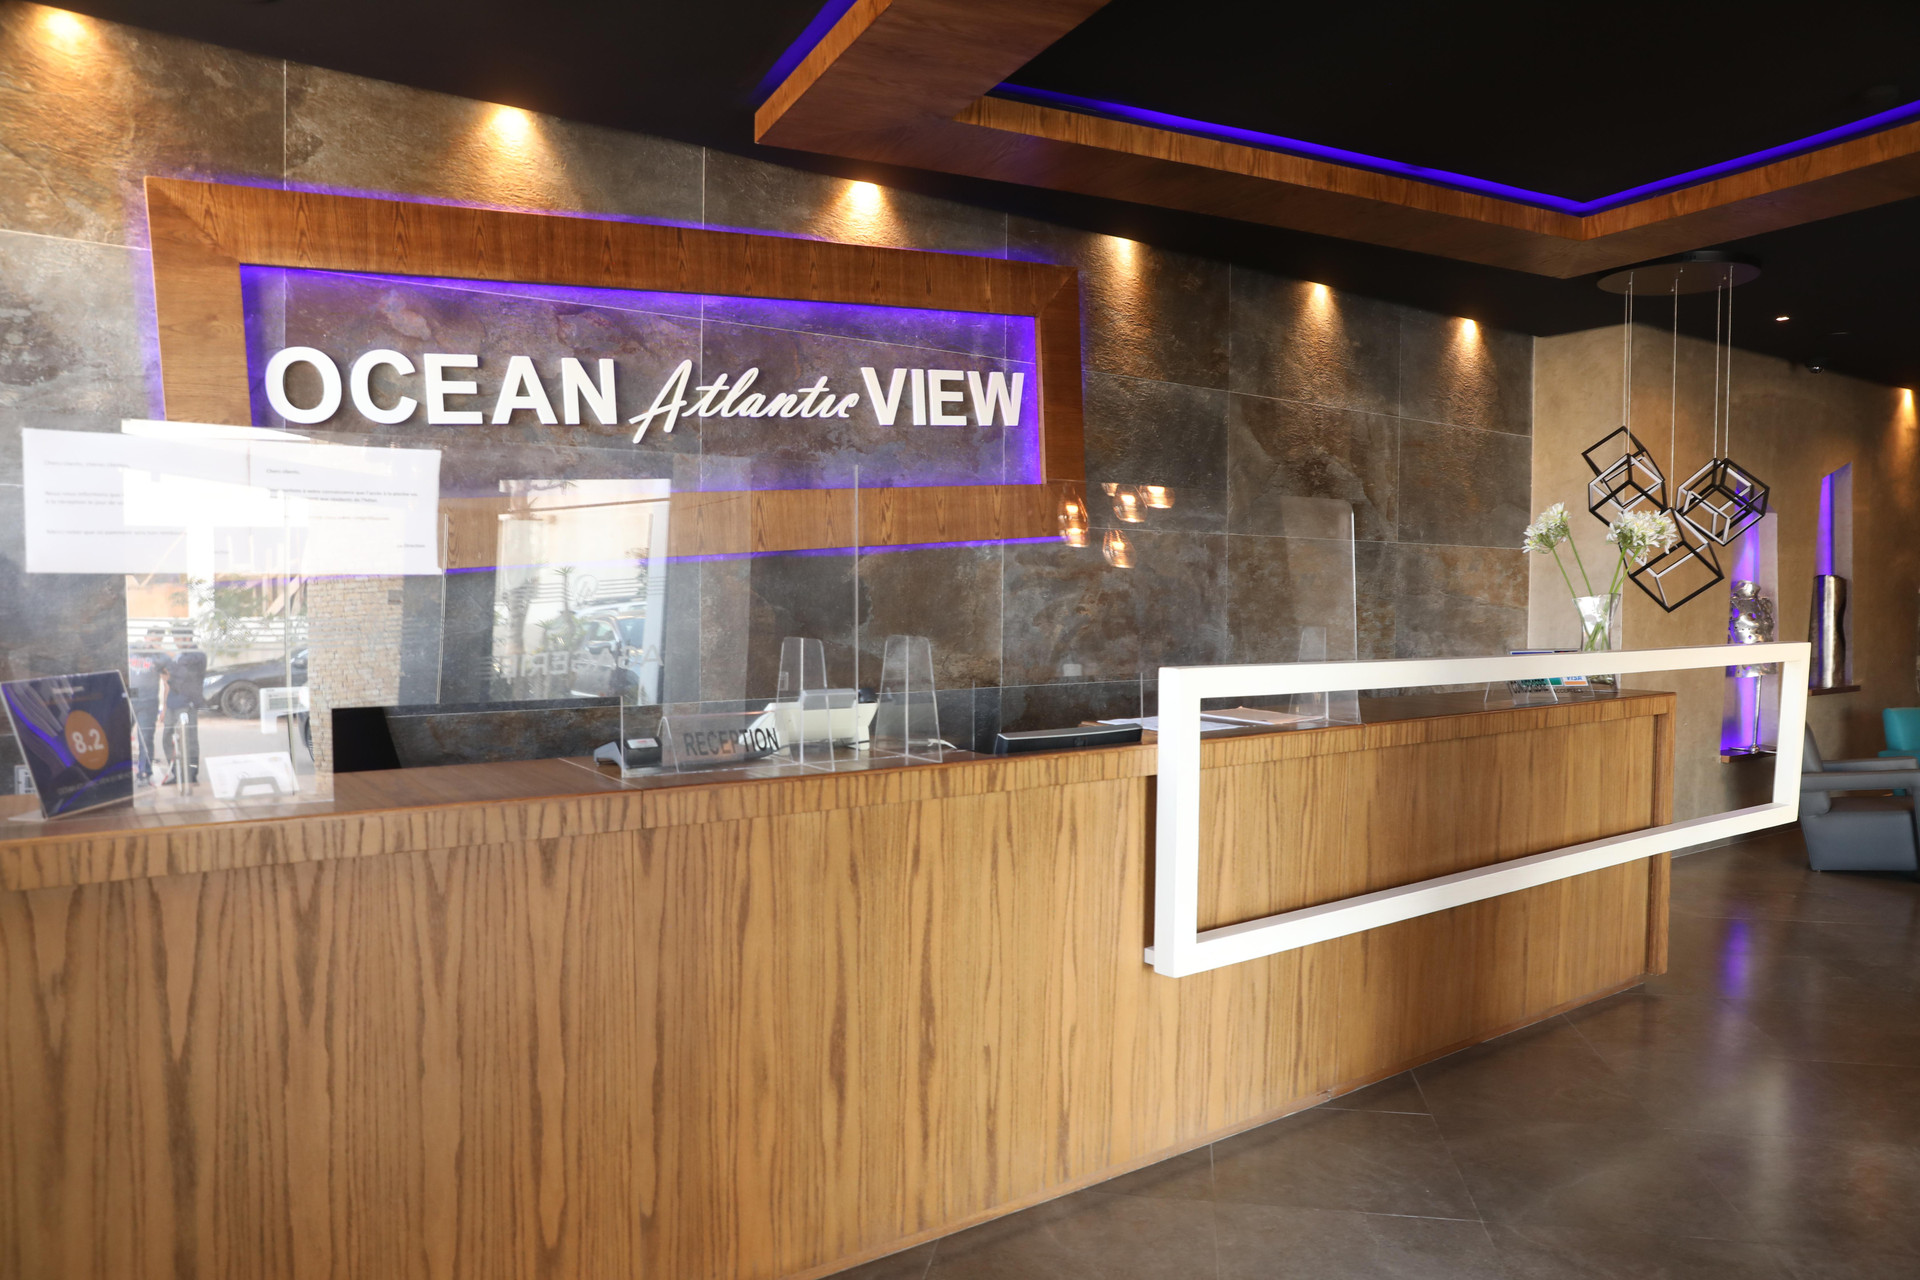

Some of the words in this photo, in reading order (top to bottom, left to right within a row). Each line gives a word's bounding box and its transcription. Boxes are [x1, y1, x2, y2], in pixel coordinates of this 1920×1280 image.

[265, 346, 618, 425] OCEAN
[628, 360, 859, 443] Atlantic
[860, 366, 1025, 427] VIEW
[72, 728, 104, 754] 8.2
[684, 728, 780, 757] RECEPTION
